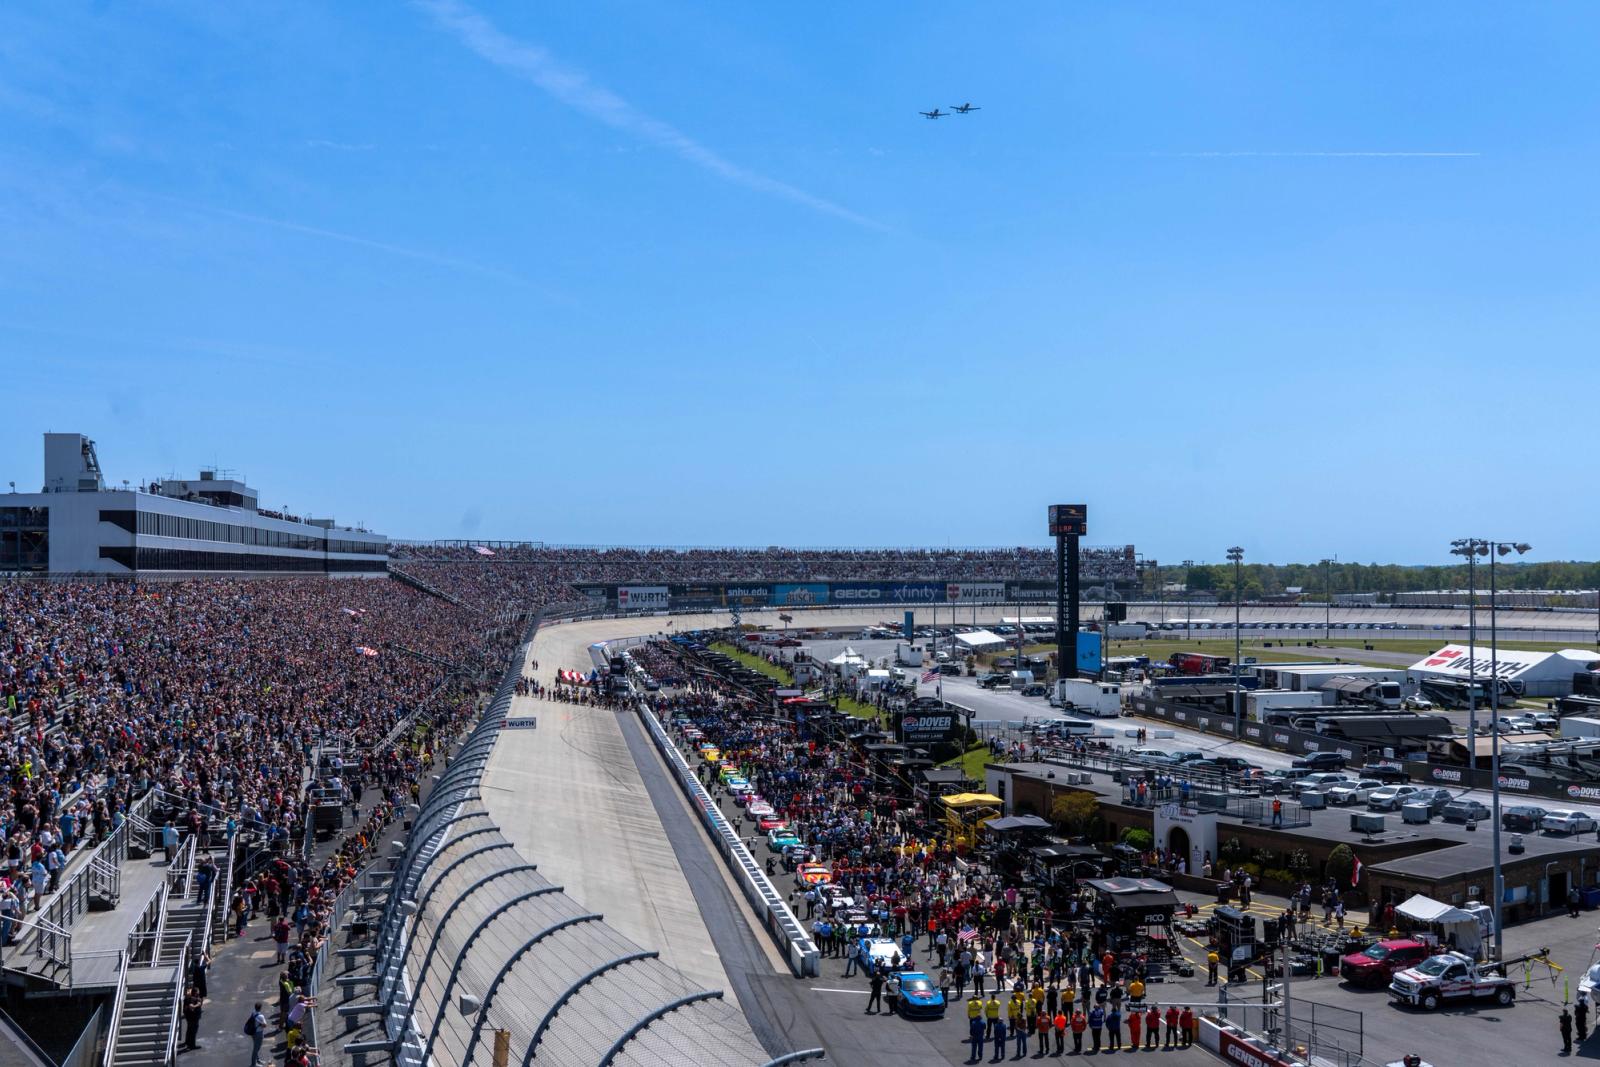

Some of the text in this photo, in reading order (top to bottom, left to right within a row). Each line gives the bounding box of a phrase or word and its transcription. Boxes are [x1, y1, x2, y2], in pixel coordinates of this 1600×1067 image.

[728, 587, 768, 596] snhu.edu
[835, 589, 881, 599] GEICO
[894, 585, 938, 601] xfinity
[919, 717, 952, 727] DOVER
[1442, 770, 1461, 779] DOVER
[1508, 778, 1530, 788] DOVER
[1580, 787, 1600, 796] DOVE
[1144, 913, 1164, 923] FICO
